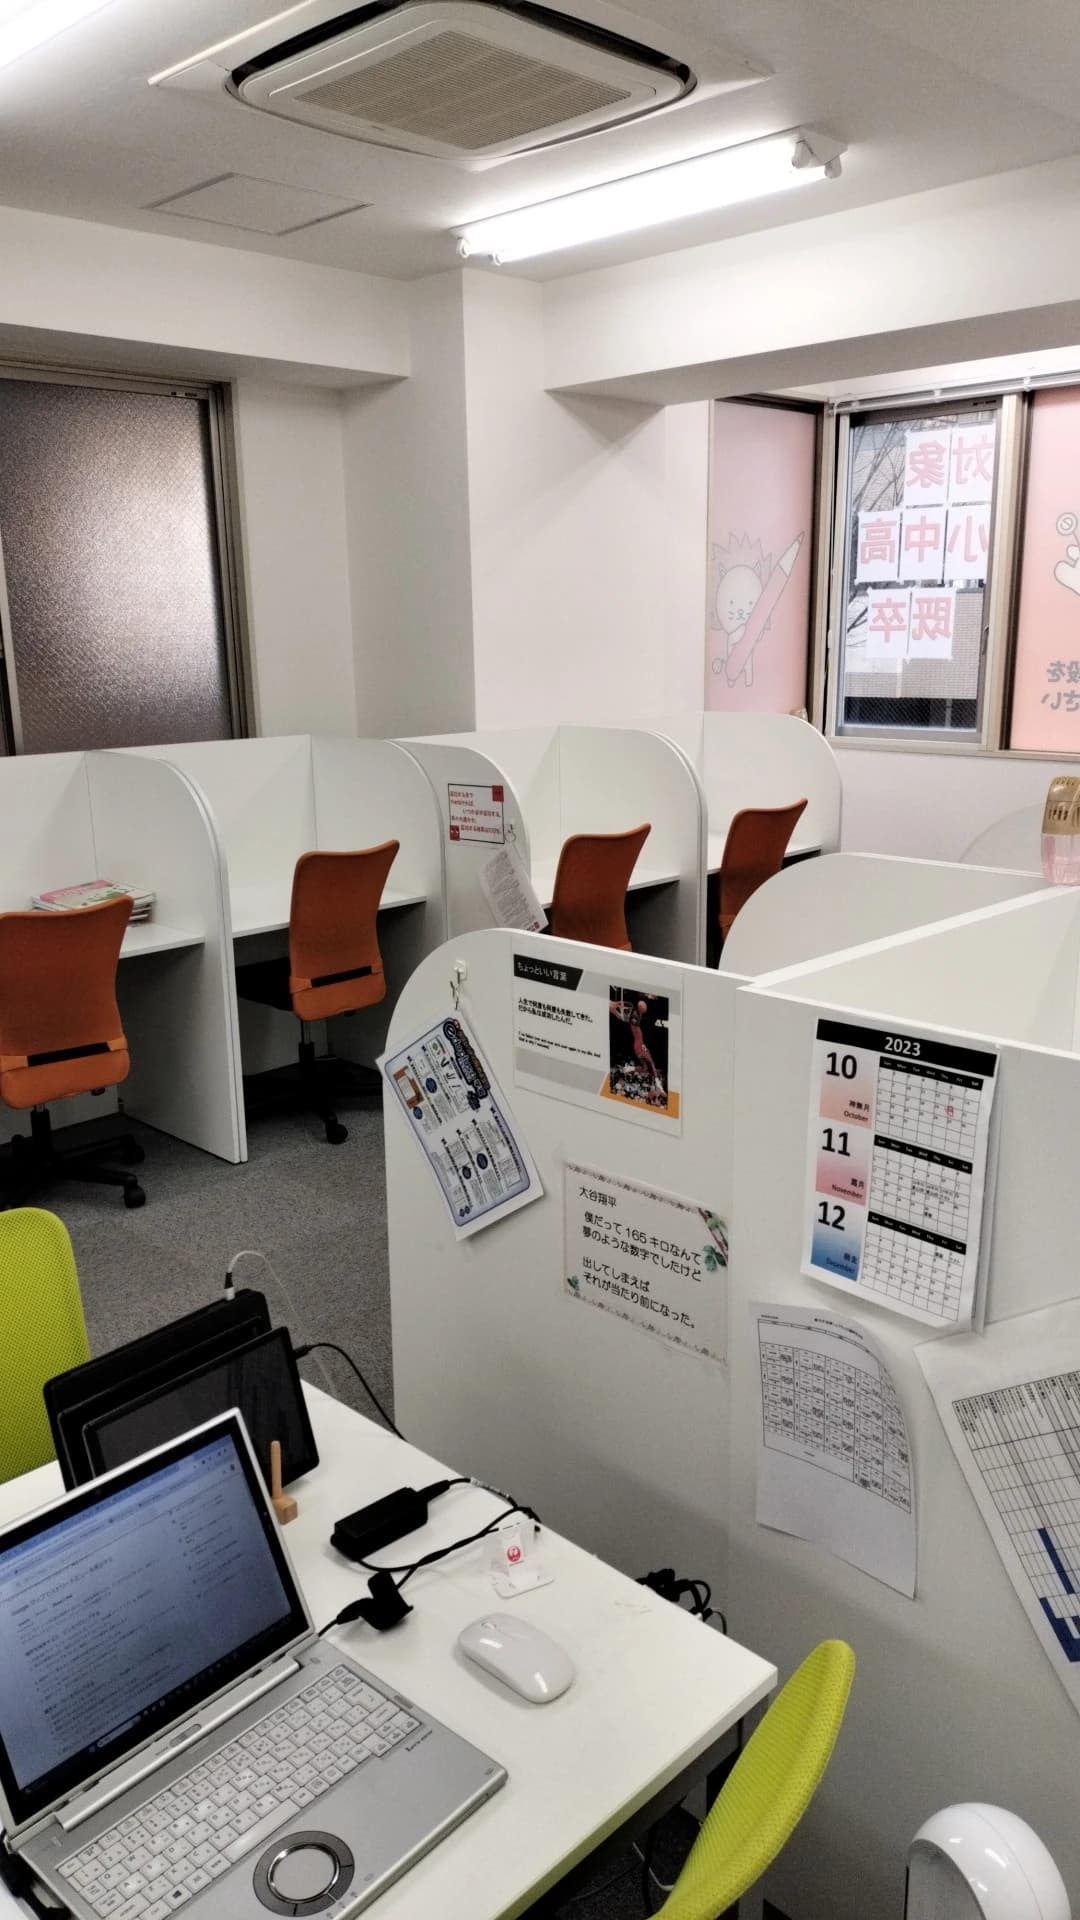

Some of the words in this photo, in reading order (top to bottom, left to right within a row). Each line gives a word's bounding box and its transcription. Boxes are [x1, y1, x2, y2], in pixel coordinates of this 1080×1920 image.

[517, 962, 567, 982] ちょっといい言葉
[884, 1036, 921, 1057] 2023
[826, 1052, 857, 1079] 10
[844, 1110, 869, 1122] October
[821, 1127, 851, 1157] 11
[579, 1186, 617, 1208] 大谷翔平
[831, 1184, 863, 1199] November
[818, 1201, 846, 1231] 12
[584, 1211, 622, 1235] 僕だって
[626, 1227, 647, 1244] 165
[650, 1236, 701, 1265] キロなんて
[583, 1225, 701, 1282] 夢のような数字でしたけど
[583, 1256, 650, 1292] 出してしまえば
[583, 1272, 695, 1328] それが当たり前になった。
